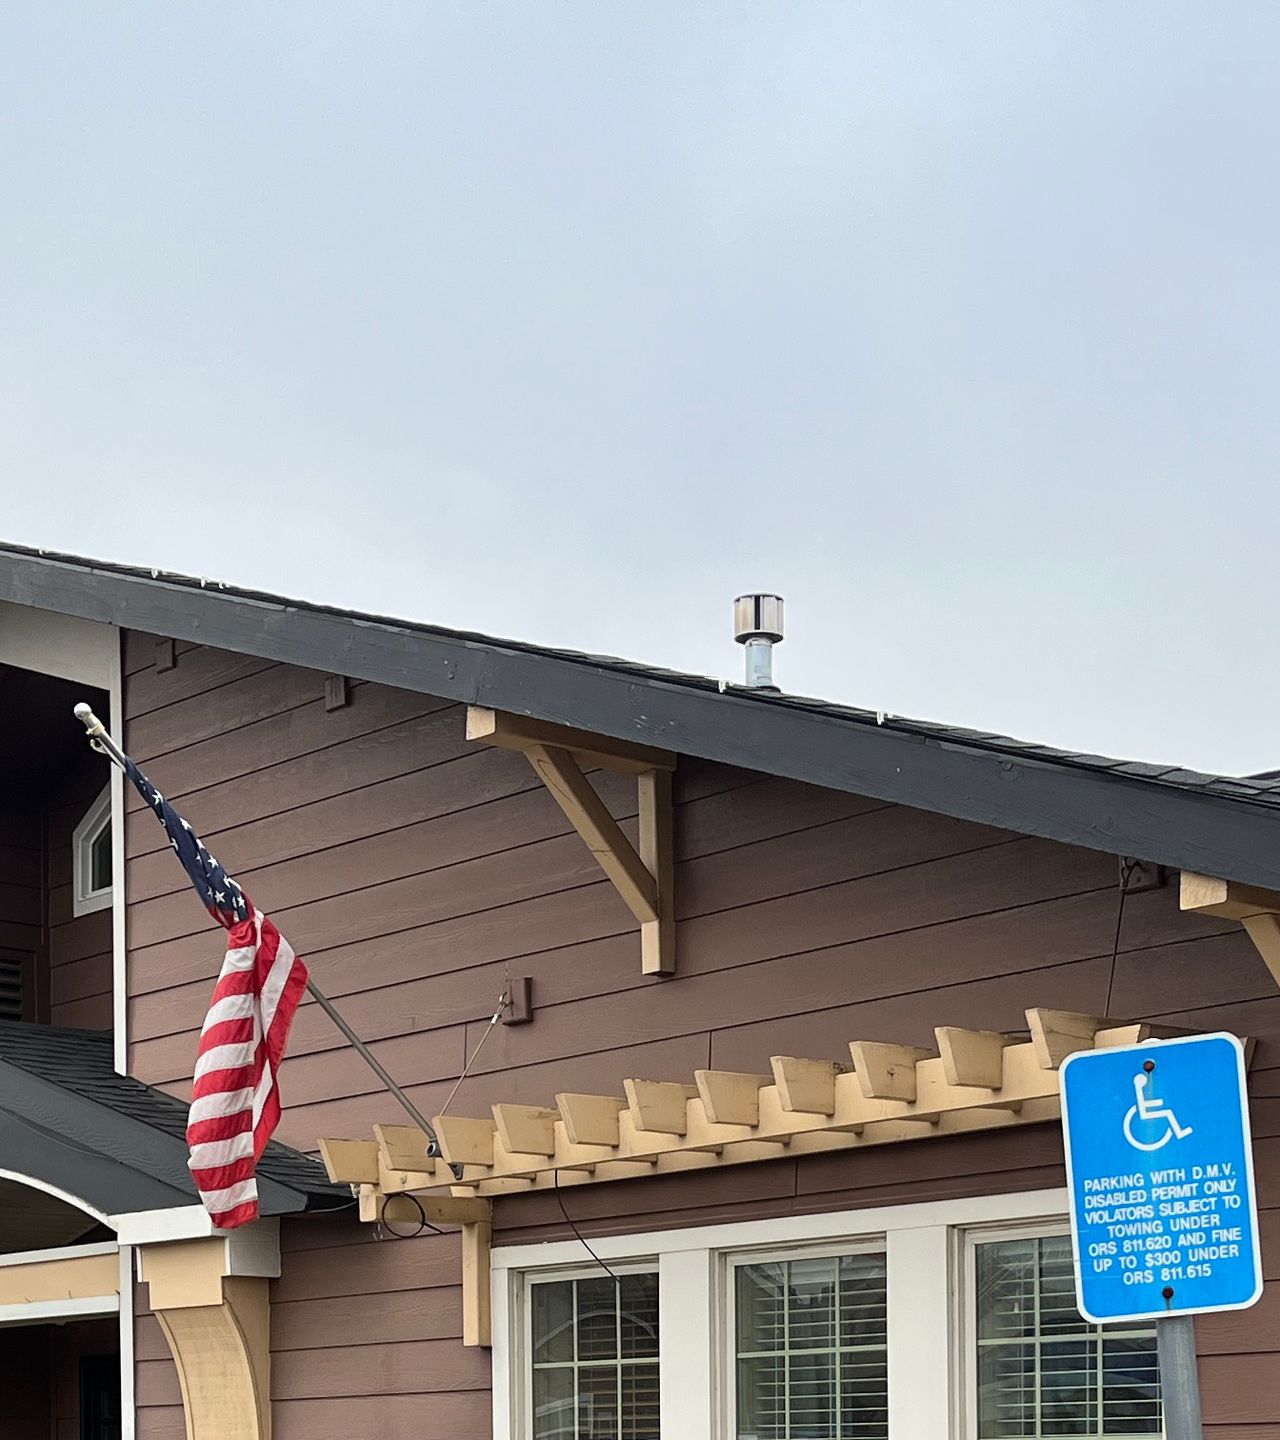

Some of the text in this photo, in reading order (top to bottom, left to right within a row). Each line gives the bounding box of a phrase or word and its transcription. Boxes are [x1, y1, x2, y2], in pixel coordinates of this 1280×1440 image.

[1084, 1163, 1236, 1192] PARKING WITH D.M.V.
[1085, 1179, 1236, 1209] DISABLED PERMIT ONLY
[1085, 1195, 1240, 1225] VIOLATORS SUBJECT TO
[1107, 1215, 1220, 1238] TOWING UNDER
[1089, 1228, 1242, 1257] ORS 811.620 AND FINE
[1094, 1245, 1239, 1272] UP TO $300 UNDER
[1123, 1264, 1211, 1285] ORS 811.615
